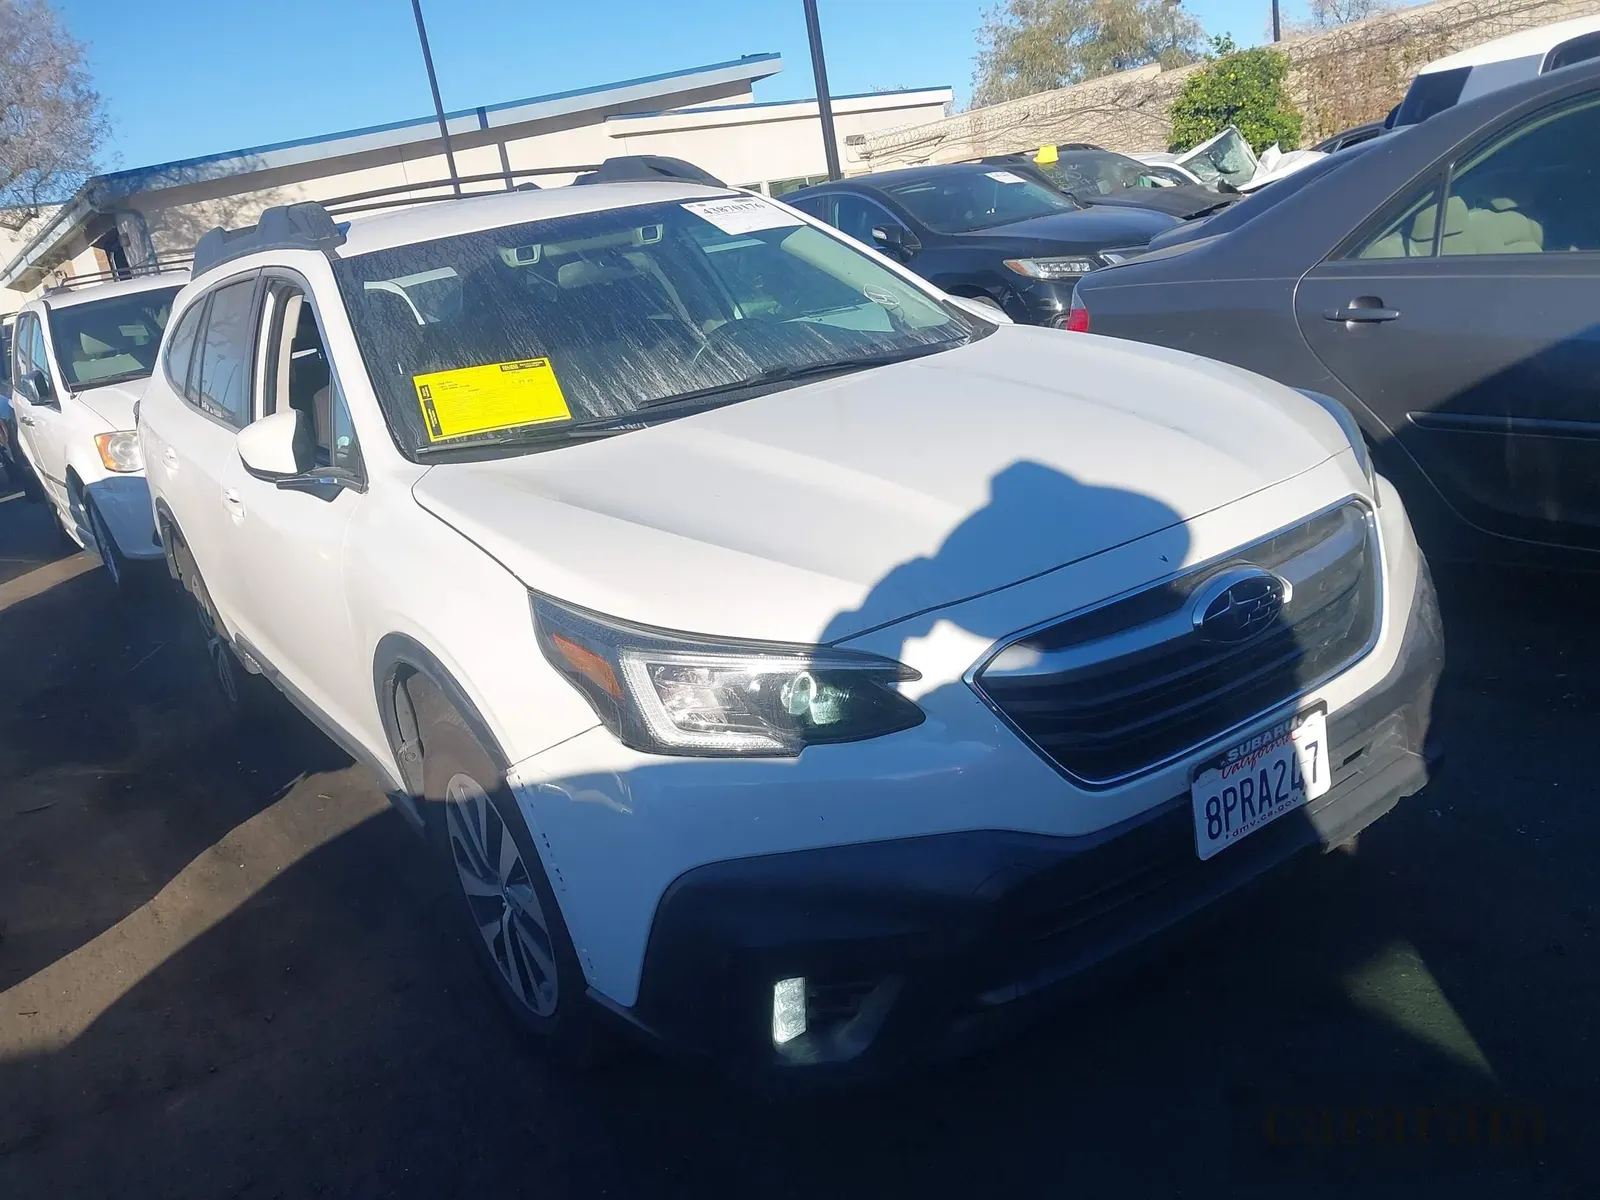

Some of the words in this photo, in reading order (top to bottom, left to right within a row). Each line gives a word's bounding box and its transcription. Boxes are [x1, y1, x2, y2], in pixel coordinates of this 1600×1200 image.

[1226, 716, 1298, 762] SUBARU
[1205, 741, 1319, 841] 8PRA247
[1232, 797, 1299, 838] dmv.ca.gov
